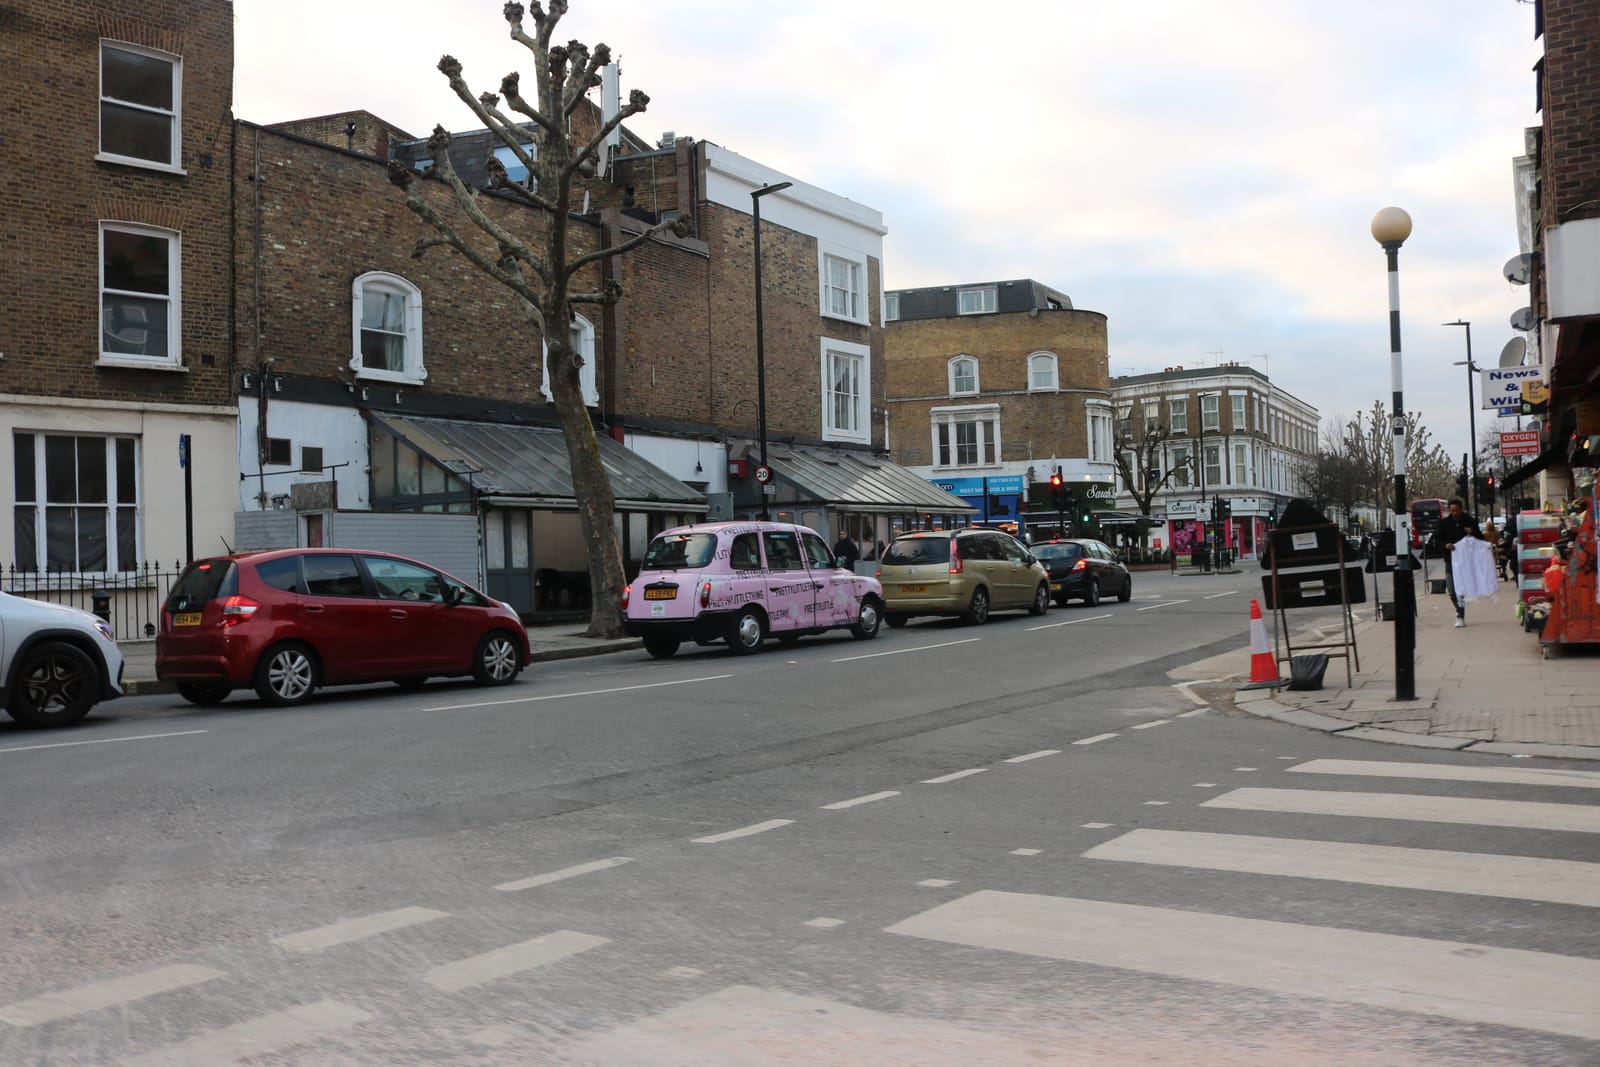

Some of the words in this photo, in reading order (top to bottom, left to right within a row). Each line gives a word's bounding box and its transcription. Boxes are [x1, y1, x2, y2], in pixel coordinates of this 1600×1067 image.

[1490, 369, 1540, 380] News
[1505, 383, 1519, 391] &
[1490, 396, 1522, 406] Win
[1503, 432, 1537, 441] OXYGEN
[1172, 502, 1192, 511] Grand
